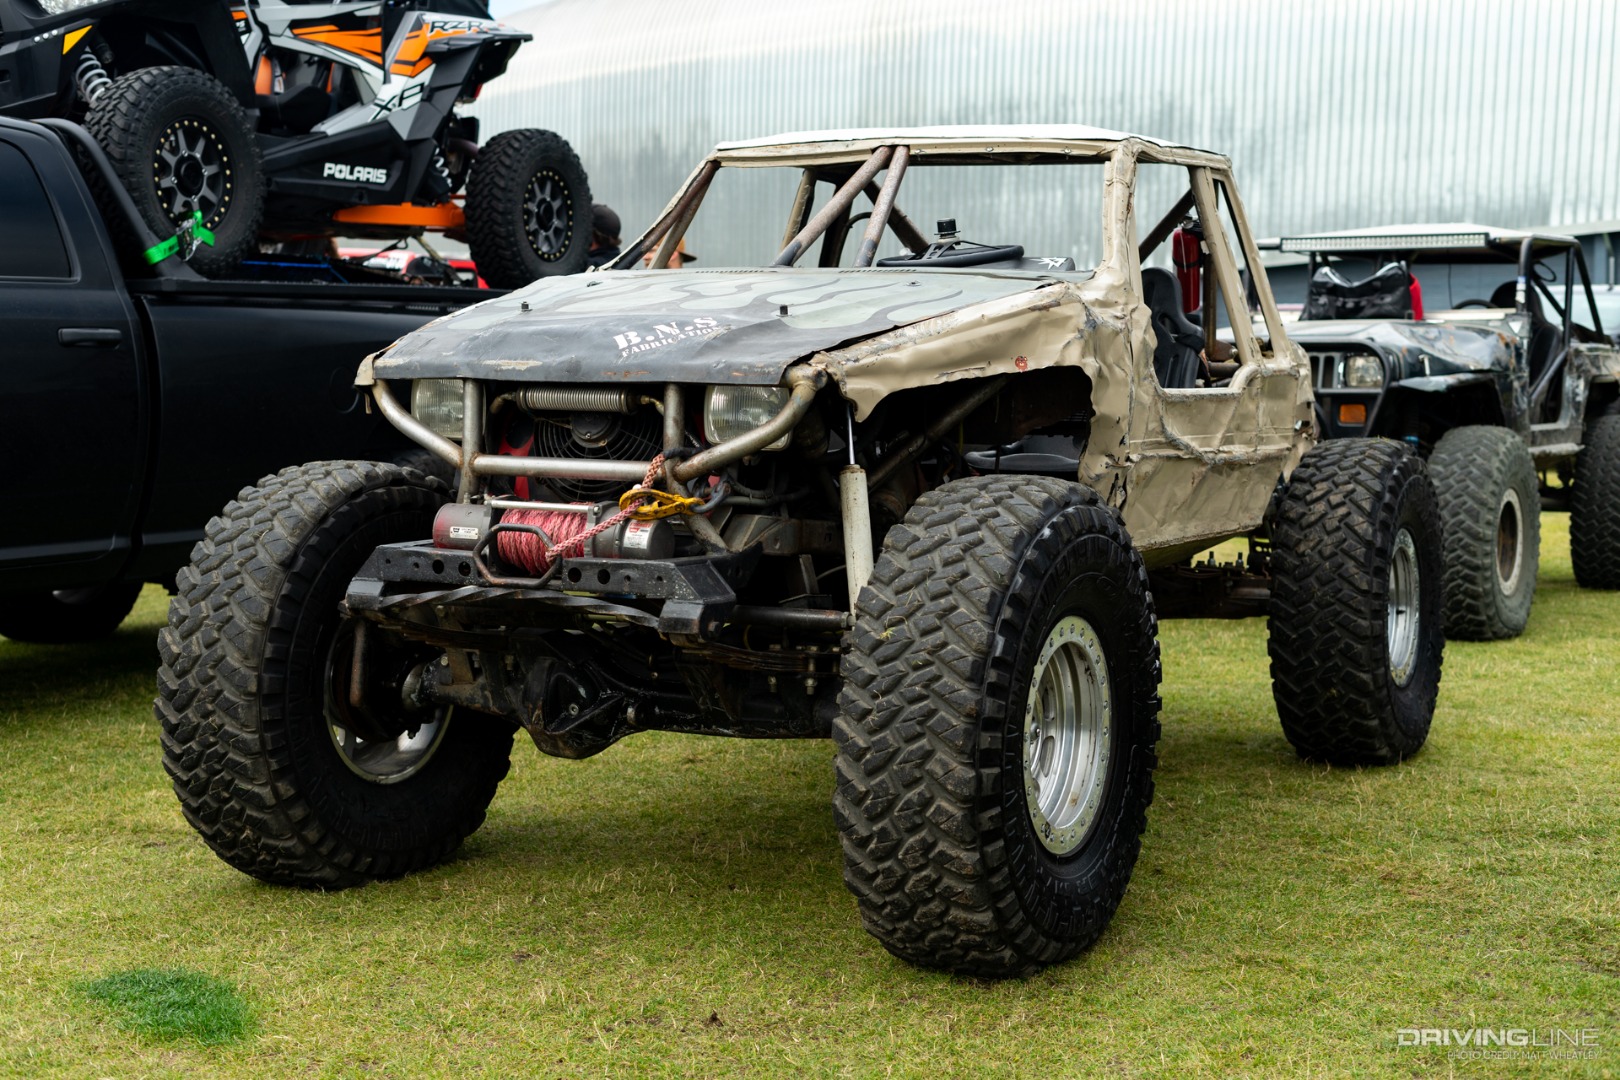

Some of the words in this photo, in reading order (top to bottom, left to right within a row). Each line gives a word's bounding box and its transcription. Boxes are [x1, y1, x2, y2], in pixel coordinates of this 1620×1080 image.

[429, 20, 489, 34] RZR
[371, 82, 425, 120] XP
[323, 162, 387, 184] POLARIS
